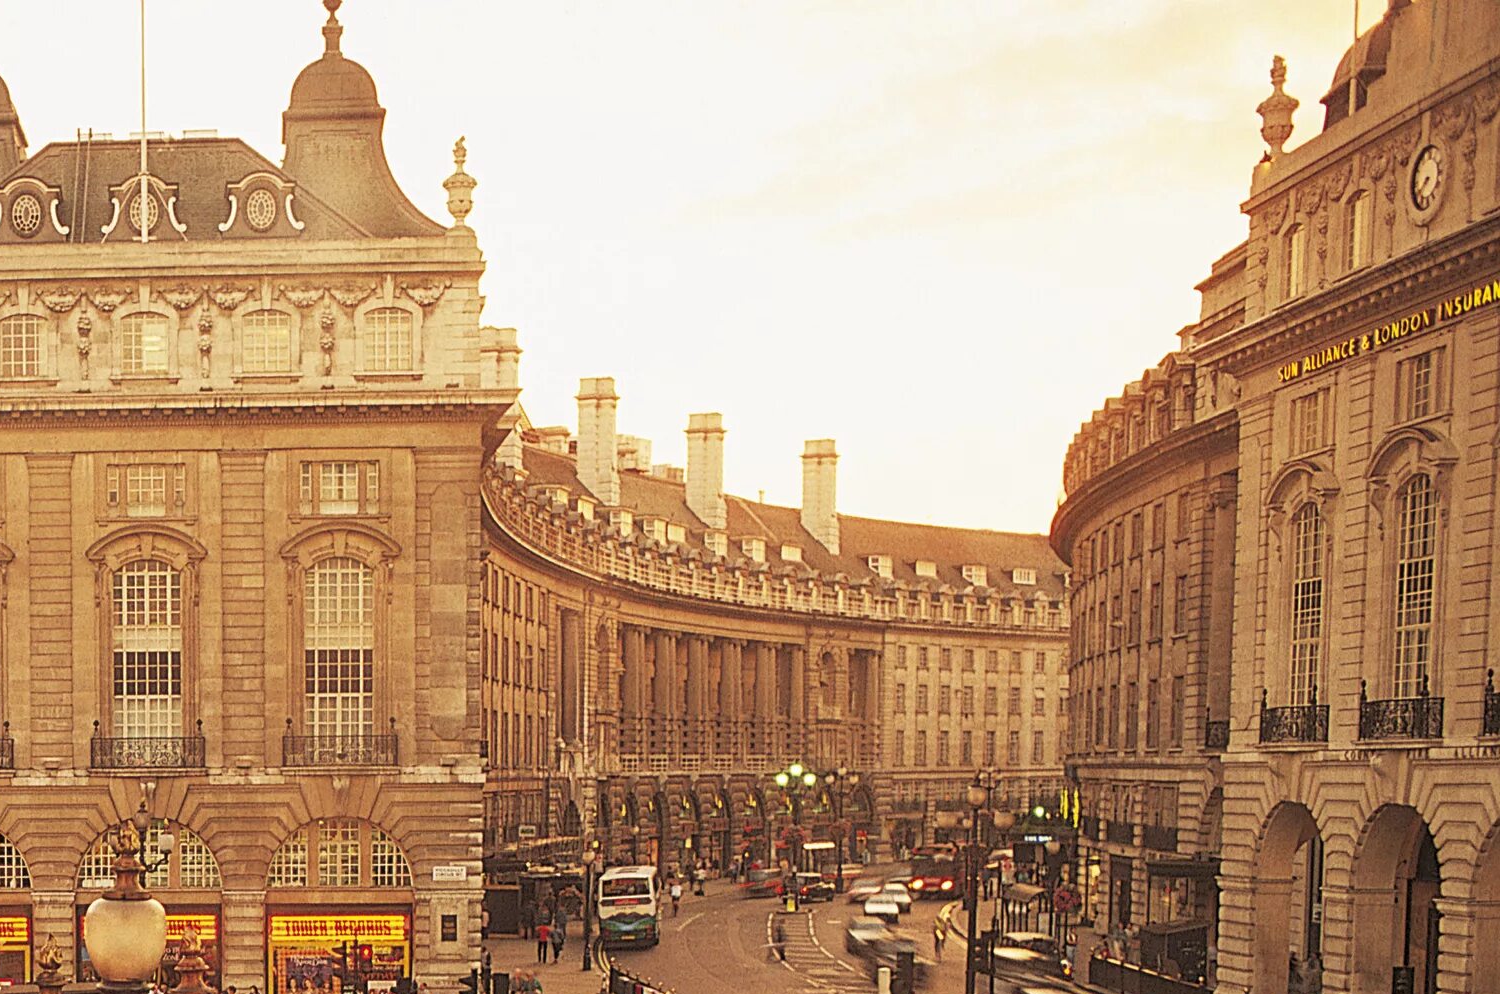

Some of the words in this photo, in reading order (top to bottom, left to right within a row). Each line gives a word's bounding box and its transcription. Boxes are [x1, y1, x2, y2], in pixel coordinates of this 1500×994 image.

[1277, 360, 1298, 382] SUN
[1303, 341, 1355, 373] ALLIANCE
[1361, 334, 1370, 351] &
[1374, 310, 1430, 346] LONDON
[285, 919, 328, 937] TOWER
[334, 919, 392, 937] RECORDS
